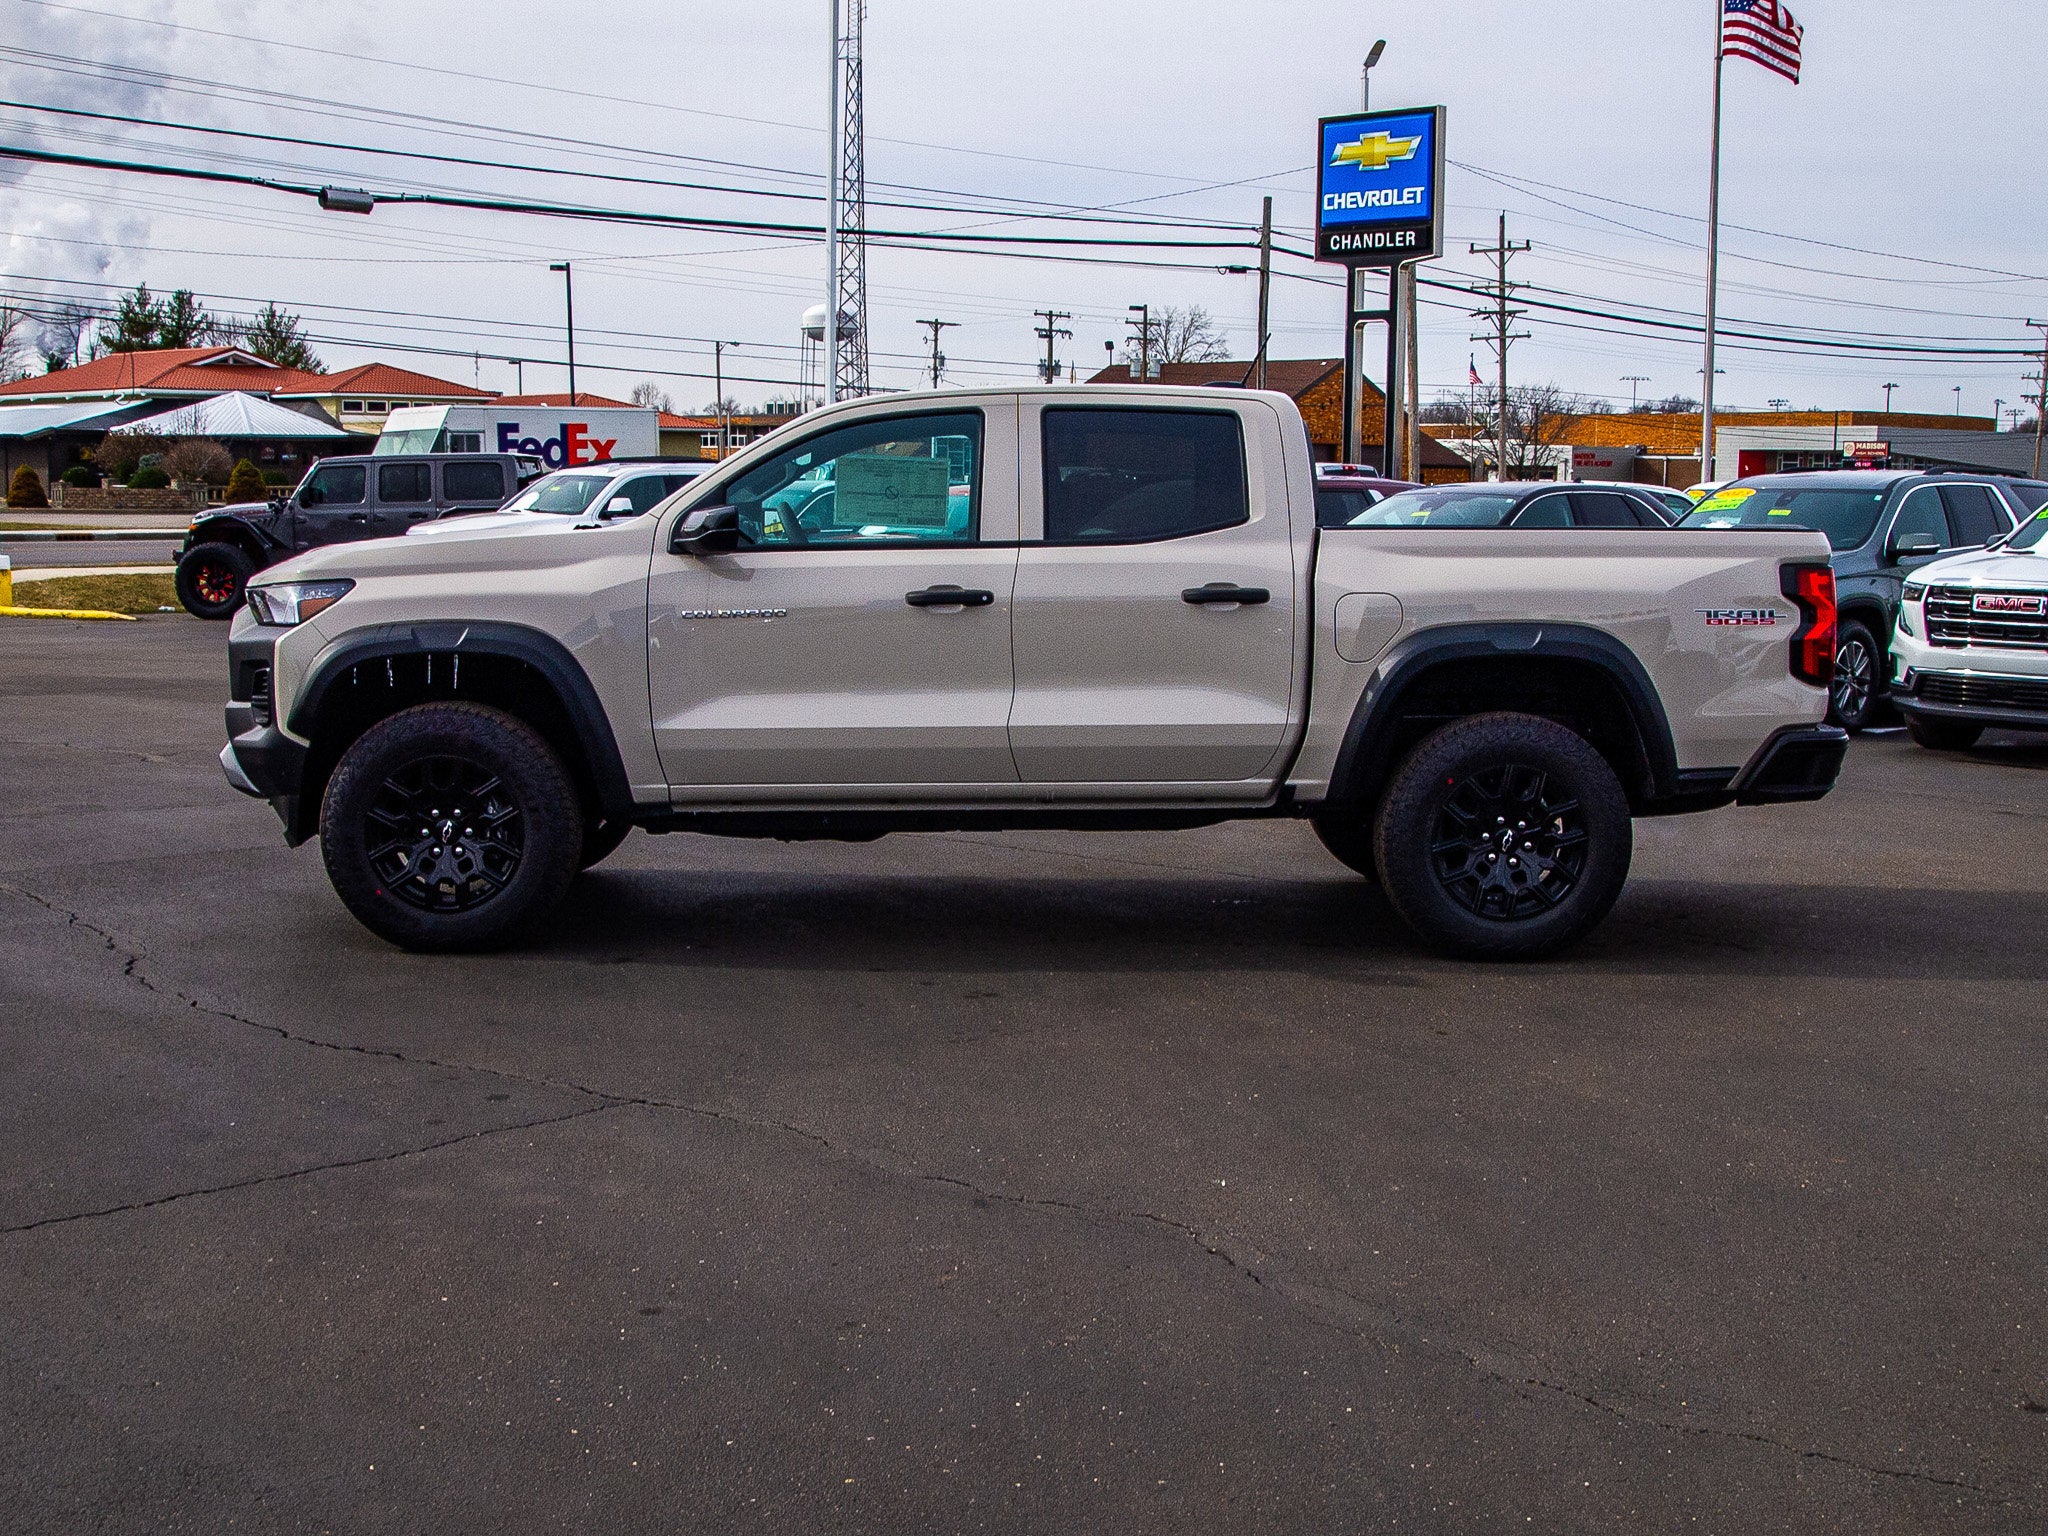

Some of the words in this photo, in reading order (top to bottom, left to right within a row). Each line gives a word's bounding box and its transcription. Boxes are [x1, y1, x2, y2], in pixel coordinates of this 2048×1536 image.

[1323, 187, 1425, 211] CHEVROLET
[1330, 231, 1416, 250] CHANDLER
[497, 423, 618, 469] FedEx
[1855, 442, 1887, 450] MADISON
[1976, 597, 2039, 611] GMC
[681, 608, 787, 619] COLORADO
[1694, 609, 1787, 619] TRAIL
[1706, 618, 1776, 626] BOSS
